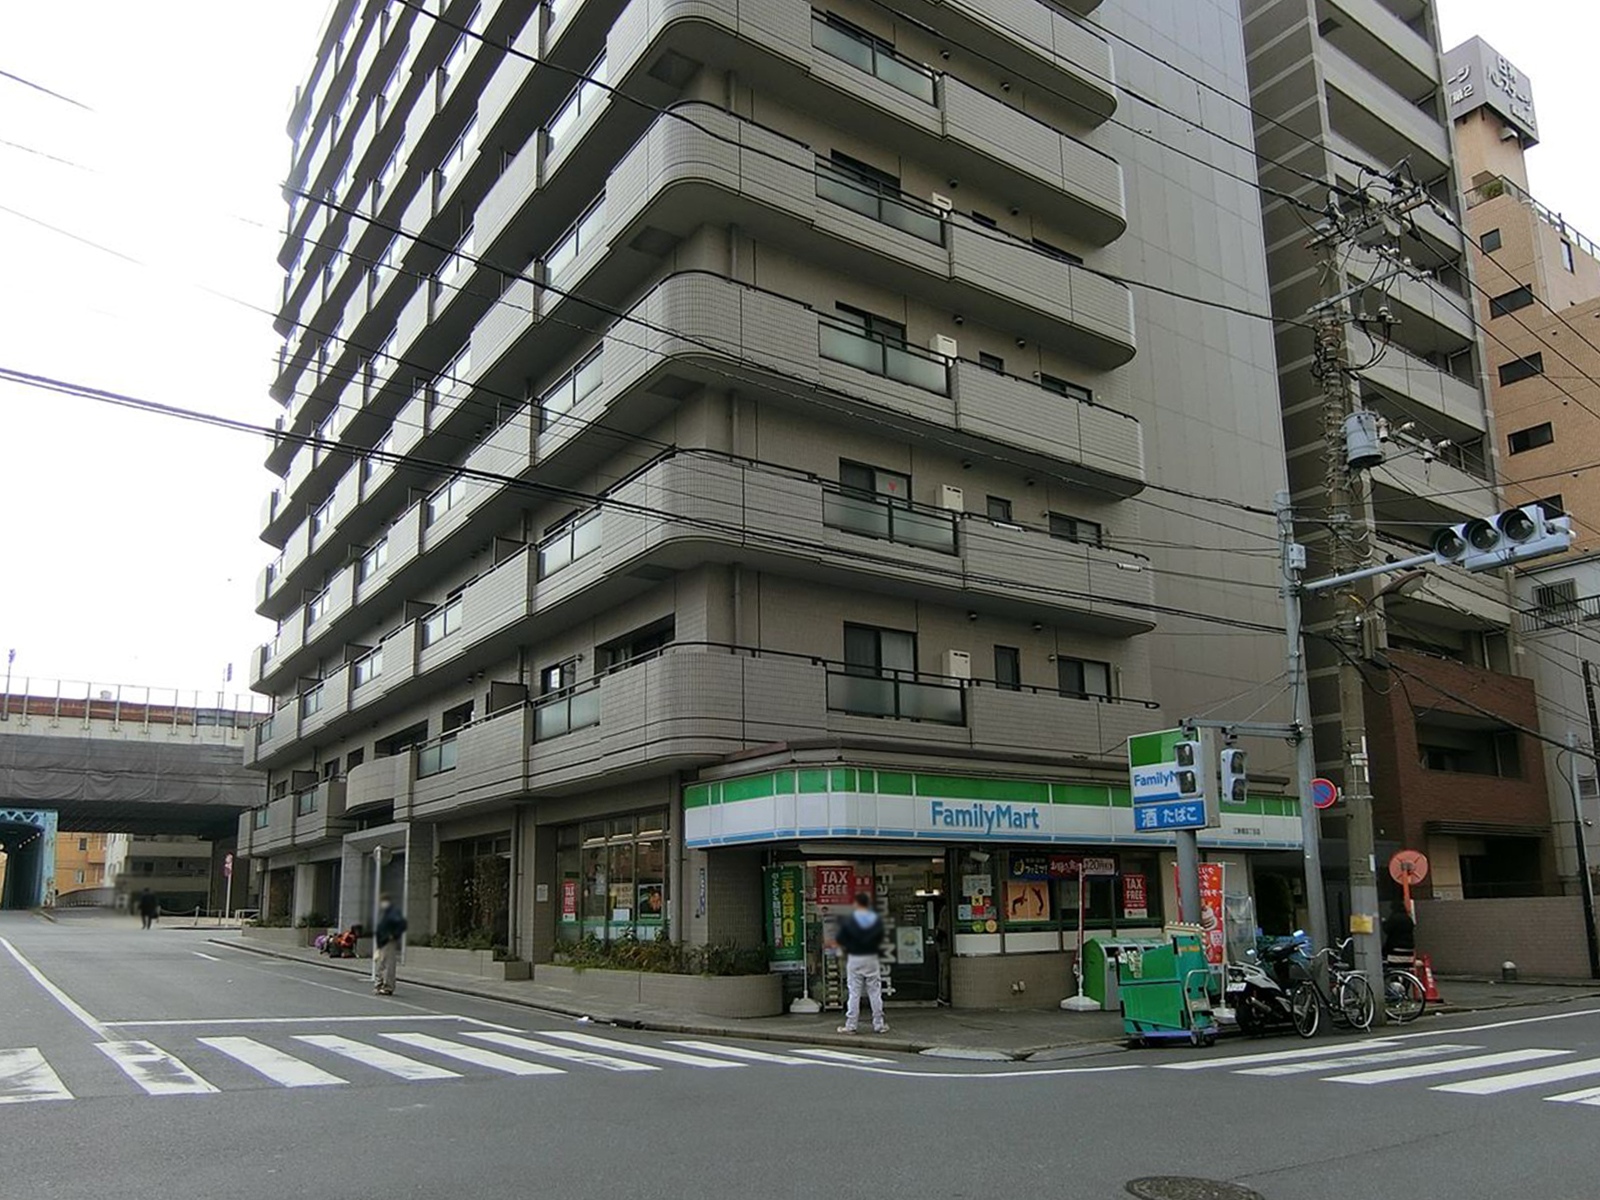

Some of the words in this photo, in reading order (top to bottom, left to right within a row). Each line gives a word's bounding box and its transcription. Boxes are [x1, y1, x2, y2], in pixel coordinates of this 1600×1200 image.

[931, 800, 1040, 835] FamilyMart
[1141, 808, 1158, 828] 酒
[1163, 806, 1198, 824] たばこ
[821, 870, 848, 884] TAX
[1126, 877, 1143, 889] TAX
[821, 884, 848, 896] FREE
[1126, 890, 1144, 900] FREE
